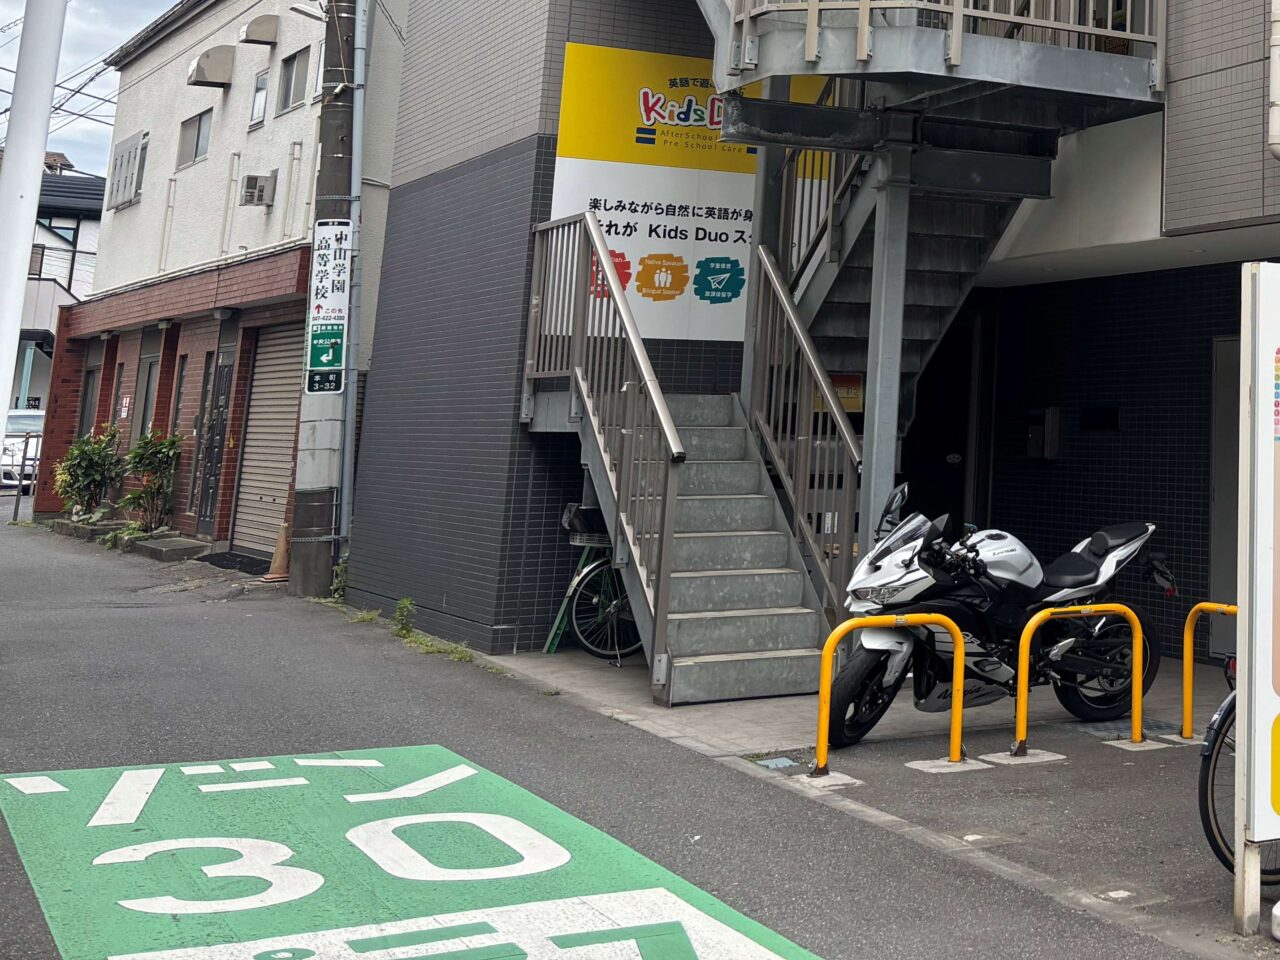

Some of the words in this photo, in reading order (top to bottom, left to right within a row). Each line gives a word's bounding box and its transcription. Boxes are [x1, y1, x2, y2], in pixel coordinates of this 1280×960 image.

[685, 142, 717, 150] School
[331, 230, 348, 294] 中山学園
[598, 219, 638, 238] れが
[648, 223, 689, 241] Kids
[694, 227, 729, 243] Duo
[733, 229, 753, 245] ス
[314, 236, 331, 300] 高等学校
[3, 758, 478, 827] ゾーン
[91, 811, 571, 914] 30
